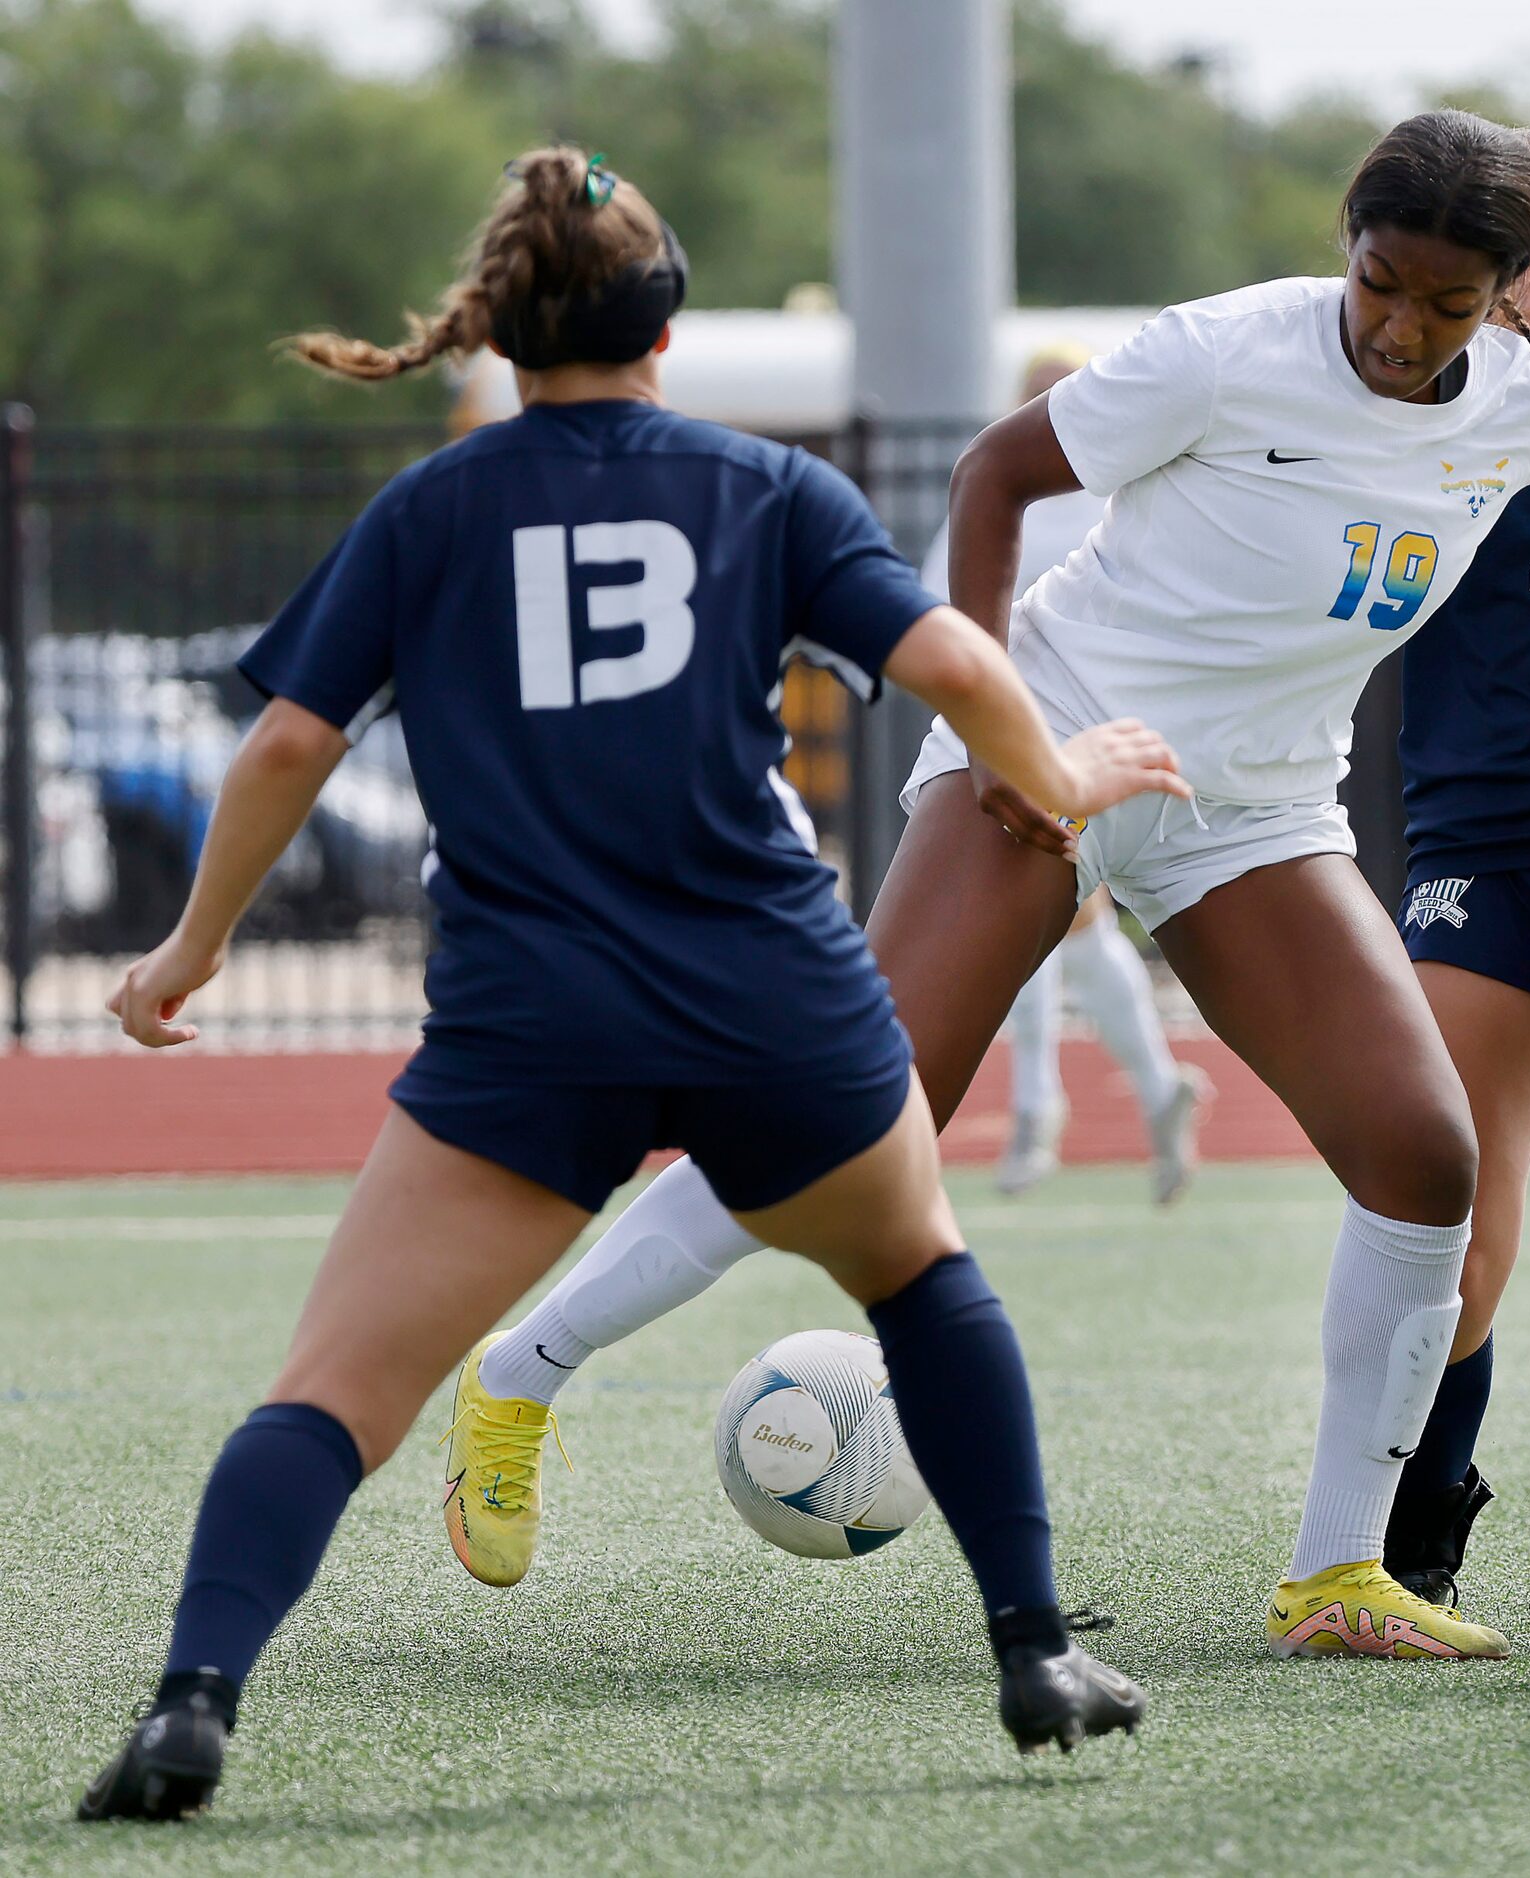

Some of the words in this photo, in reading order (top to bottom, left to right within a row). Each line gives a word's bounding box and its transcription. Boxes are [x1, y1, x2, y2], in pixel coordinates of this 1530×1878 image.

[1327, 521, 1439, 631] 19
[513, 519, 697, 710] 13
[1417, 899, 1445, 908] REEDY
[752, 1423, 813, 1453] Baden
